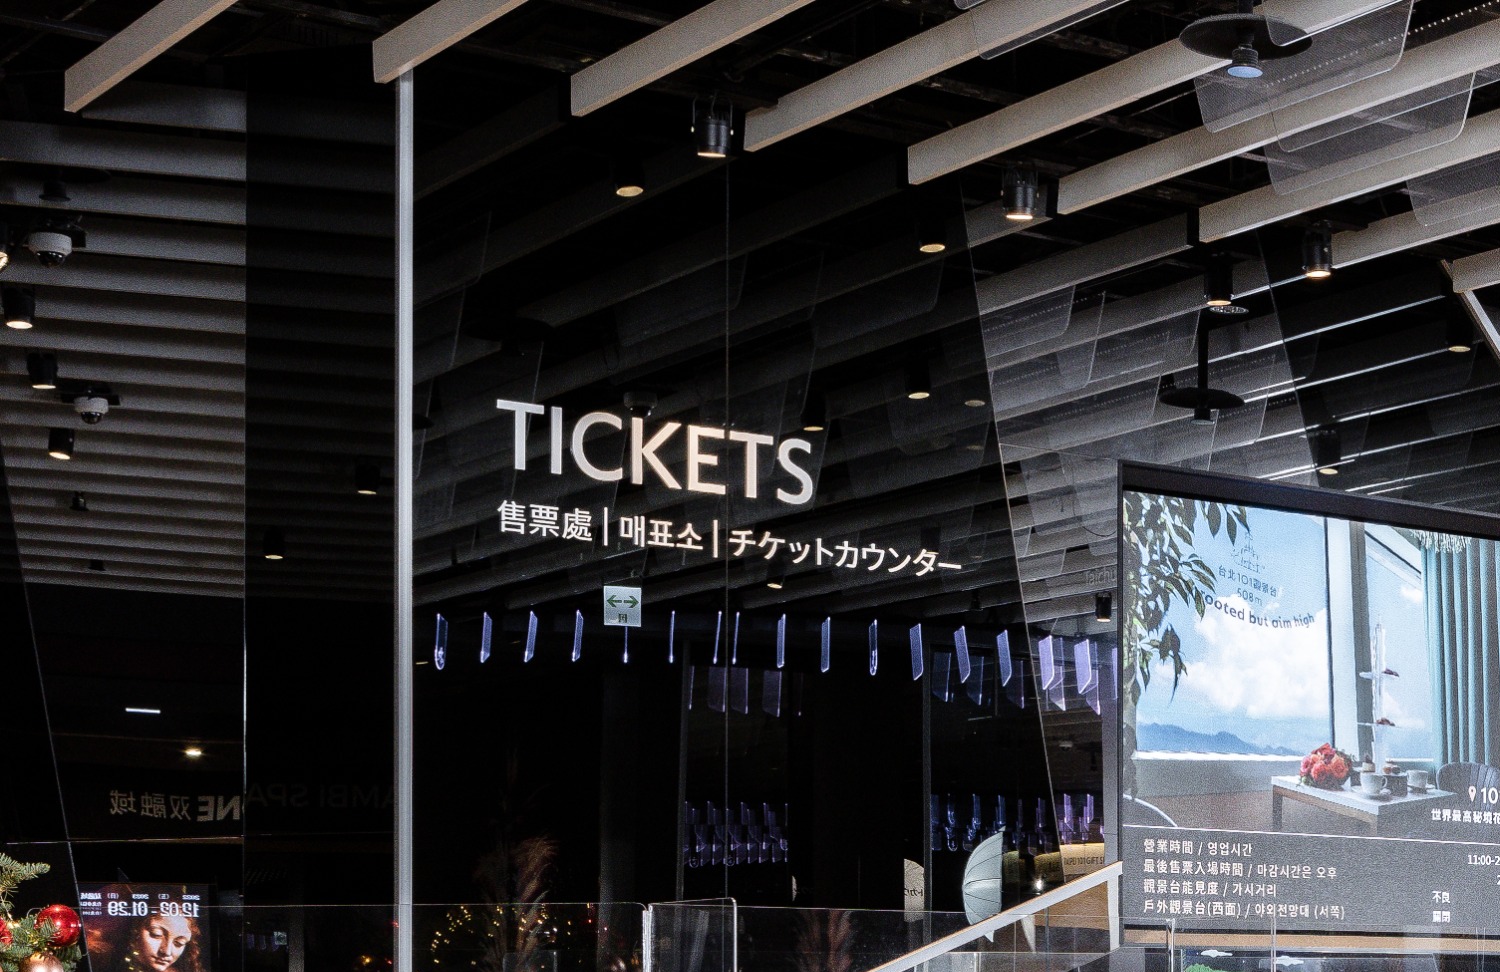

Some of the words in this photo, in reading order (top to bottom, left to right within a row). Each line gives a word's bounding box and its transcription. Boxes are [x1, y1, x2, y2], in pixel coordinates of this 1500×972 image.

[496, 398, 814, 505] TICKETS
[497, 500, 593, 542] 售票處
[619, 515, 704, 551] 매표소
[728, 529, 962, 577] チケットカウンター
[1249, 610, 1269, 628] but
[1271, 616, 1292, 629] aim
[1293, 612, 1315, 629] high
[1143, 839, 1193, 855] 營業時間
[1207, 842, 1253, 857] 영업시간
[1143, 858, 1244, 877] 最後售票入場時間
[1257, 864, 1312, 879] 마감시간은
[1316, 866, 1337, 880] 오후
[1143, 878, 1219, 896] 觀景台能見度
[1232, 882, 1277, 898] 가시거리
[1432, 890, 1451, 904] 不良
[1143, 899, 1241, 919] 戶外觀景台(西面)
[1255, 903, 1310, 918] 야외전망대
[1314, 904, 1345, 920] (서쪽)
